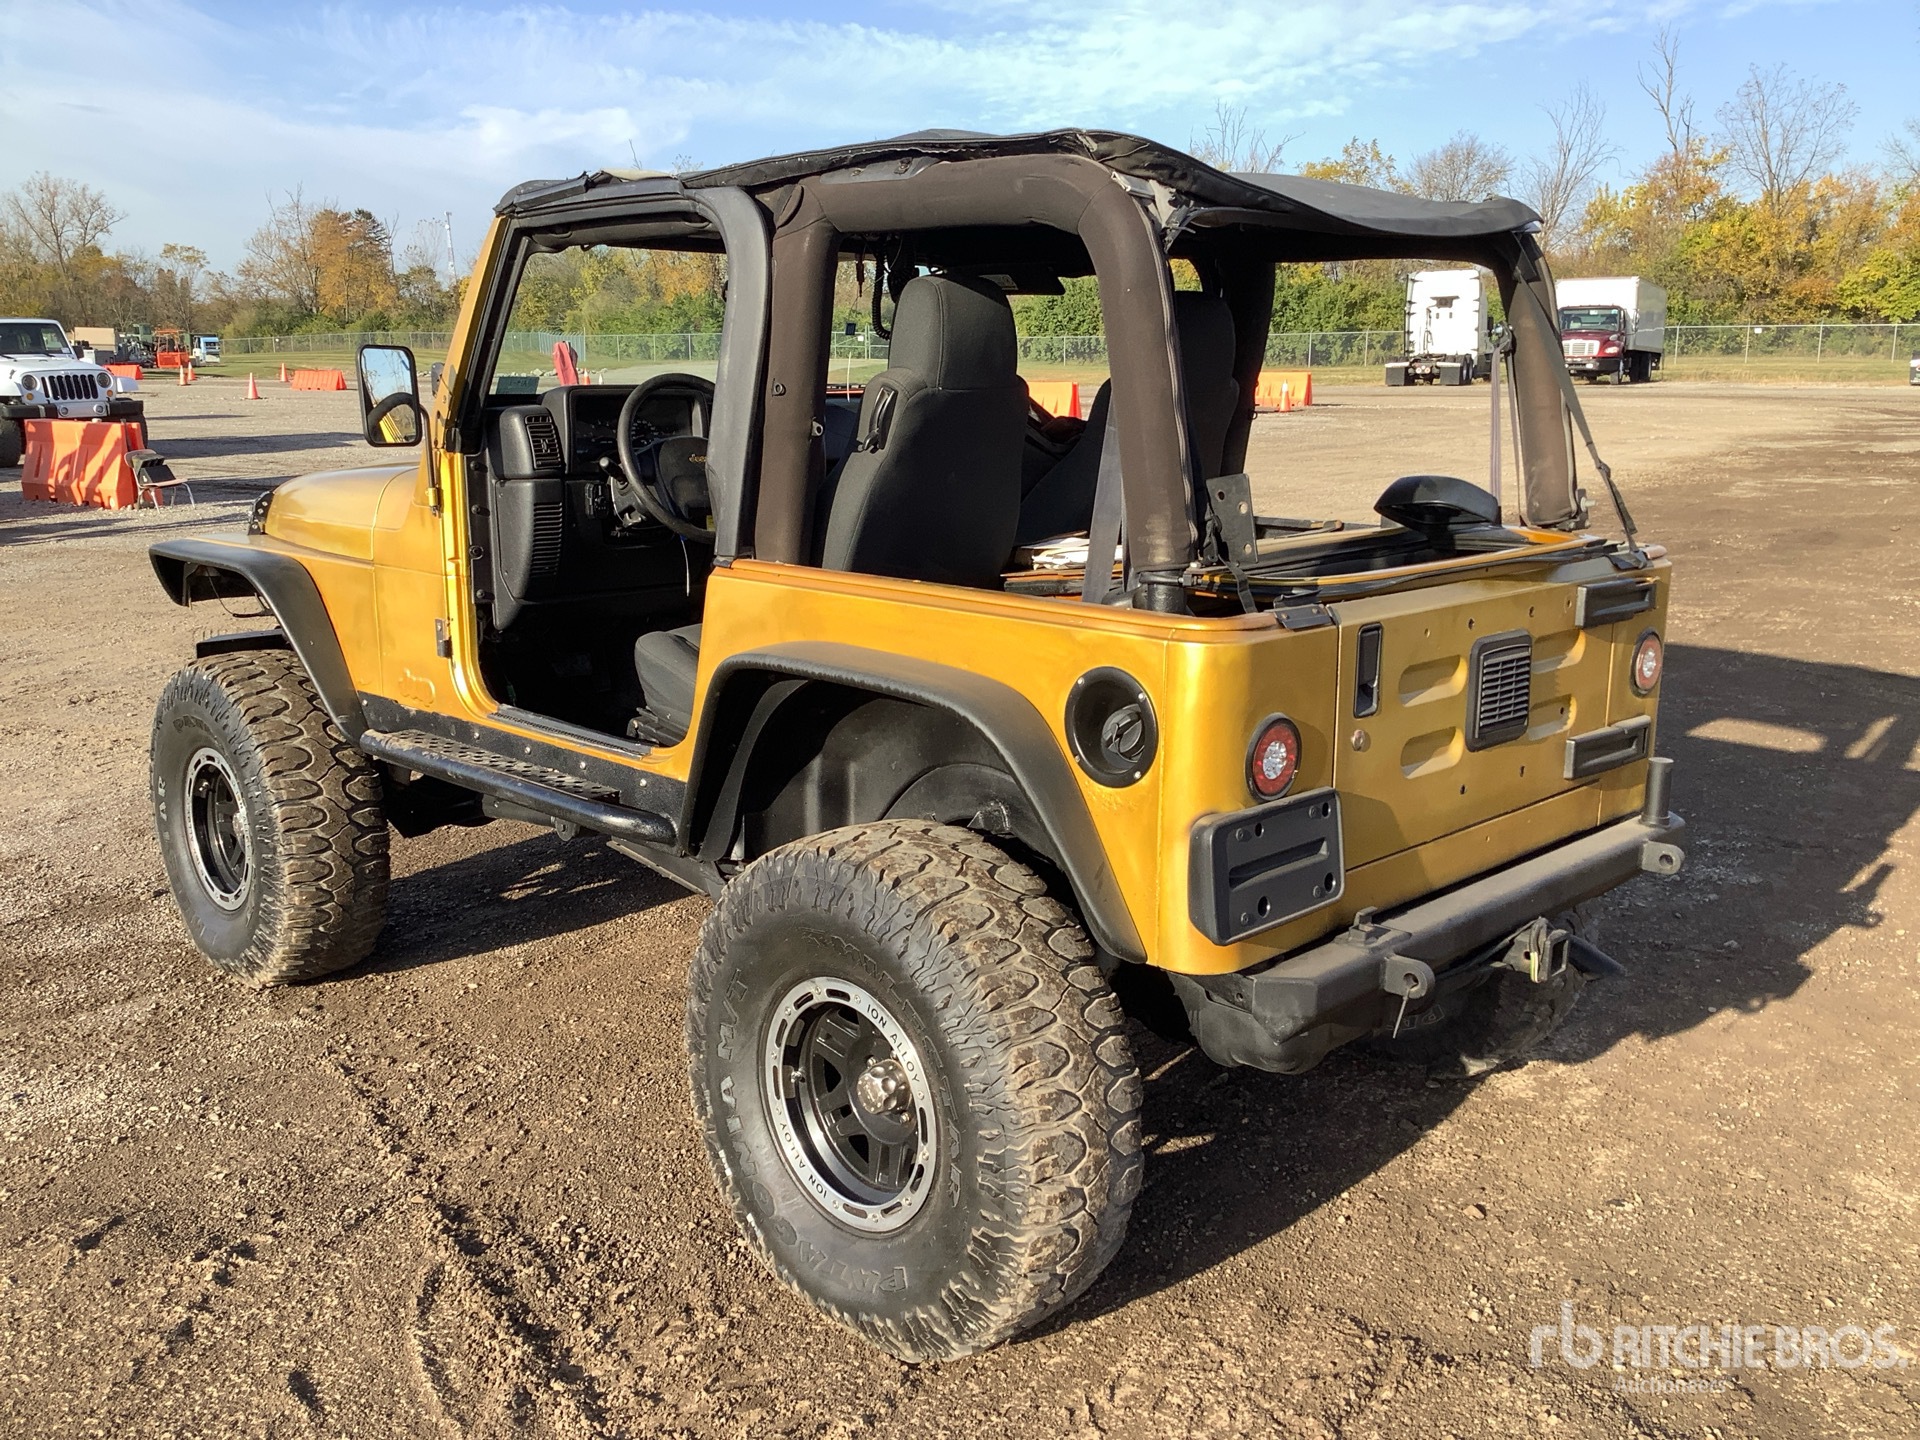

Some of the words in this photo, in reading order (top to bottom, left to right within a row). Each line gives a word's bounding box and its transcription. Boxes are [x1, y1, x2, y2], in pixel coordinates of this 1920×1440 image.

[866, 1003, 888, 1029] ION
[889, 1033, 921, 1083] ALLOY
[780, 1122, 806, 1169] ALLOY
[720, 1075, 909, 1293] PATAGONIA
[808, 1174, 828, 1199] ION
